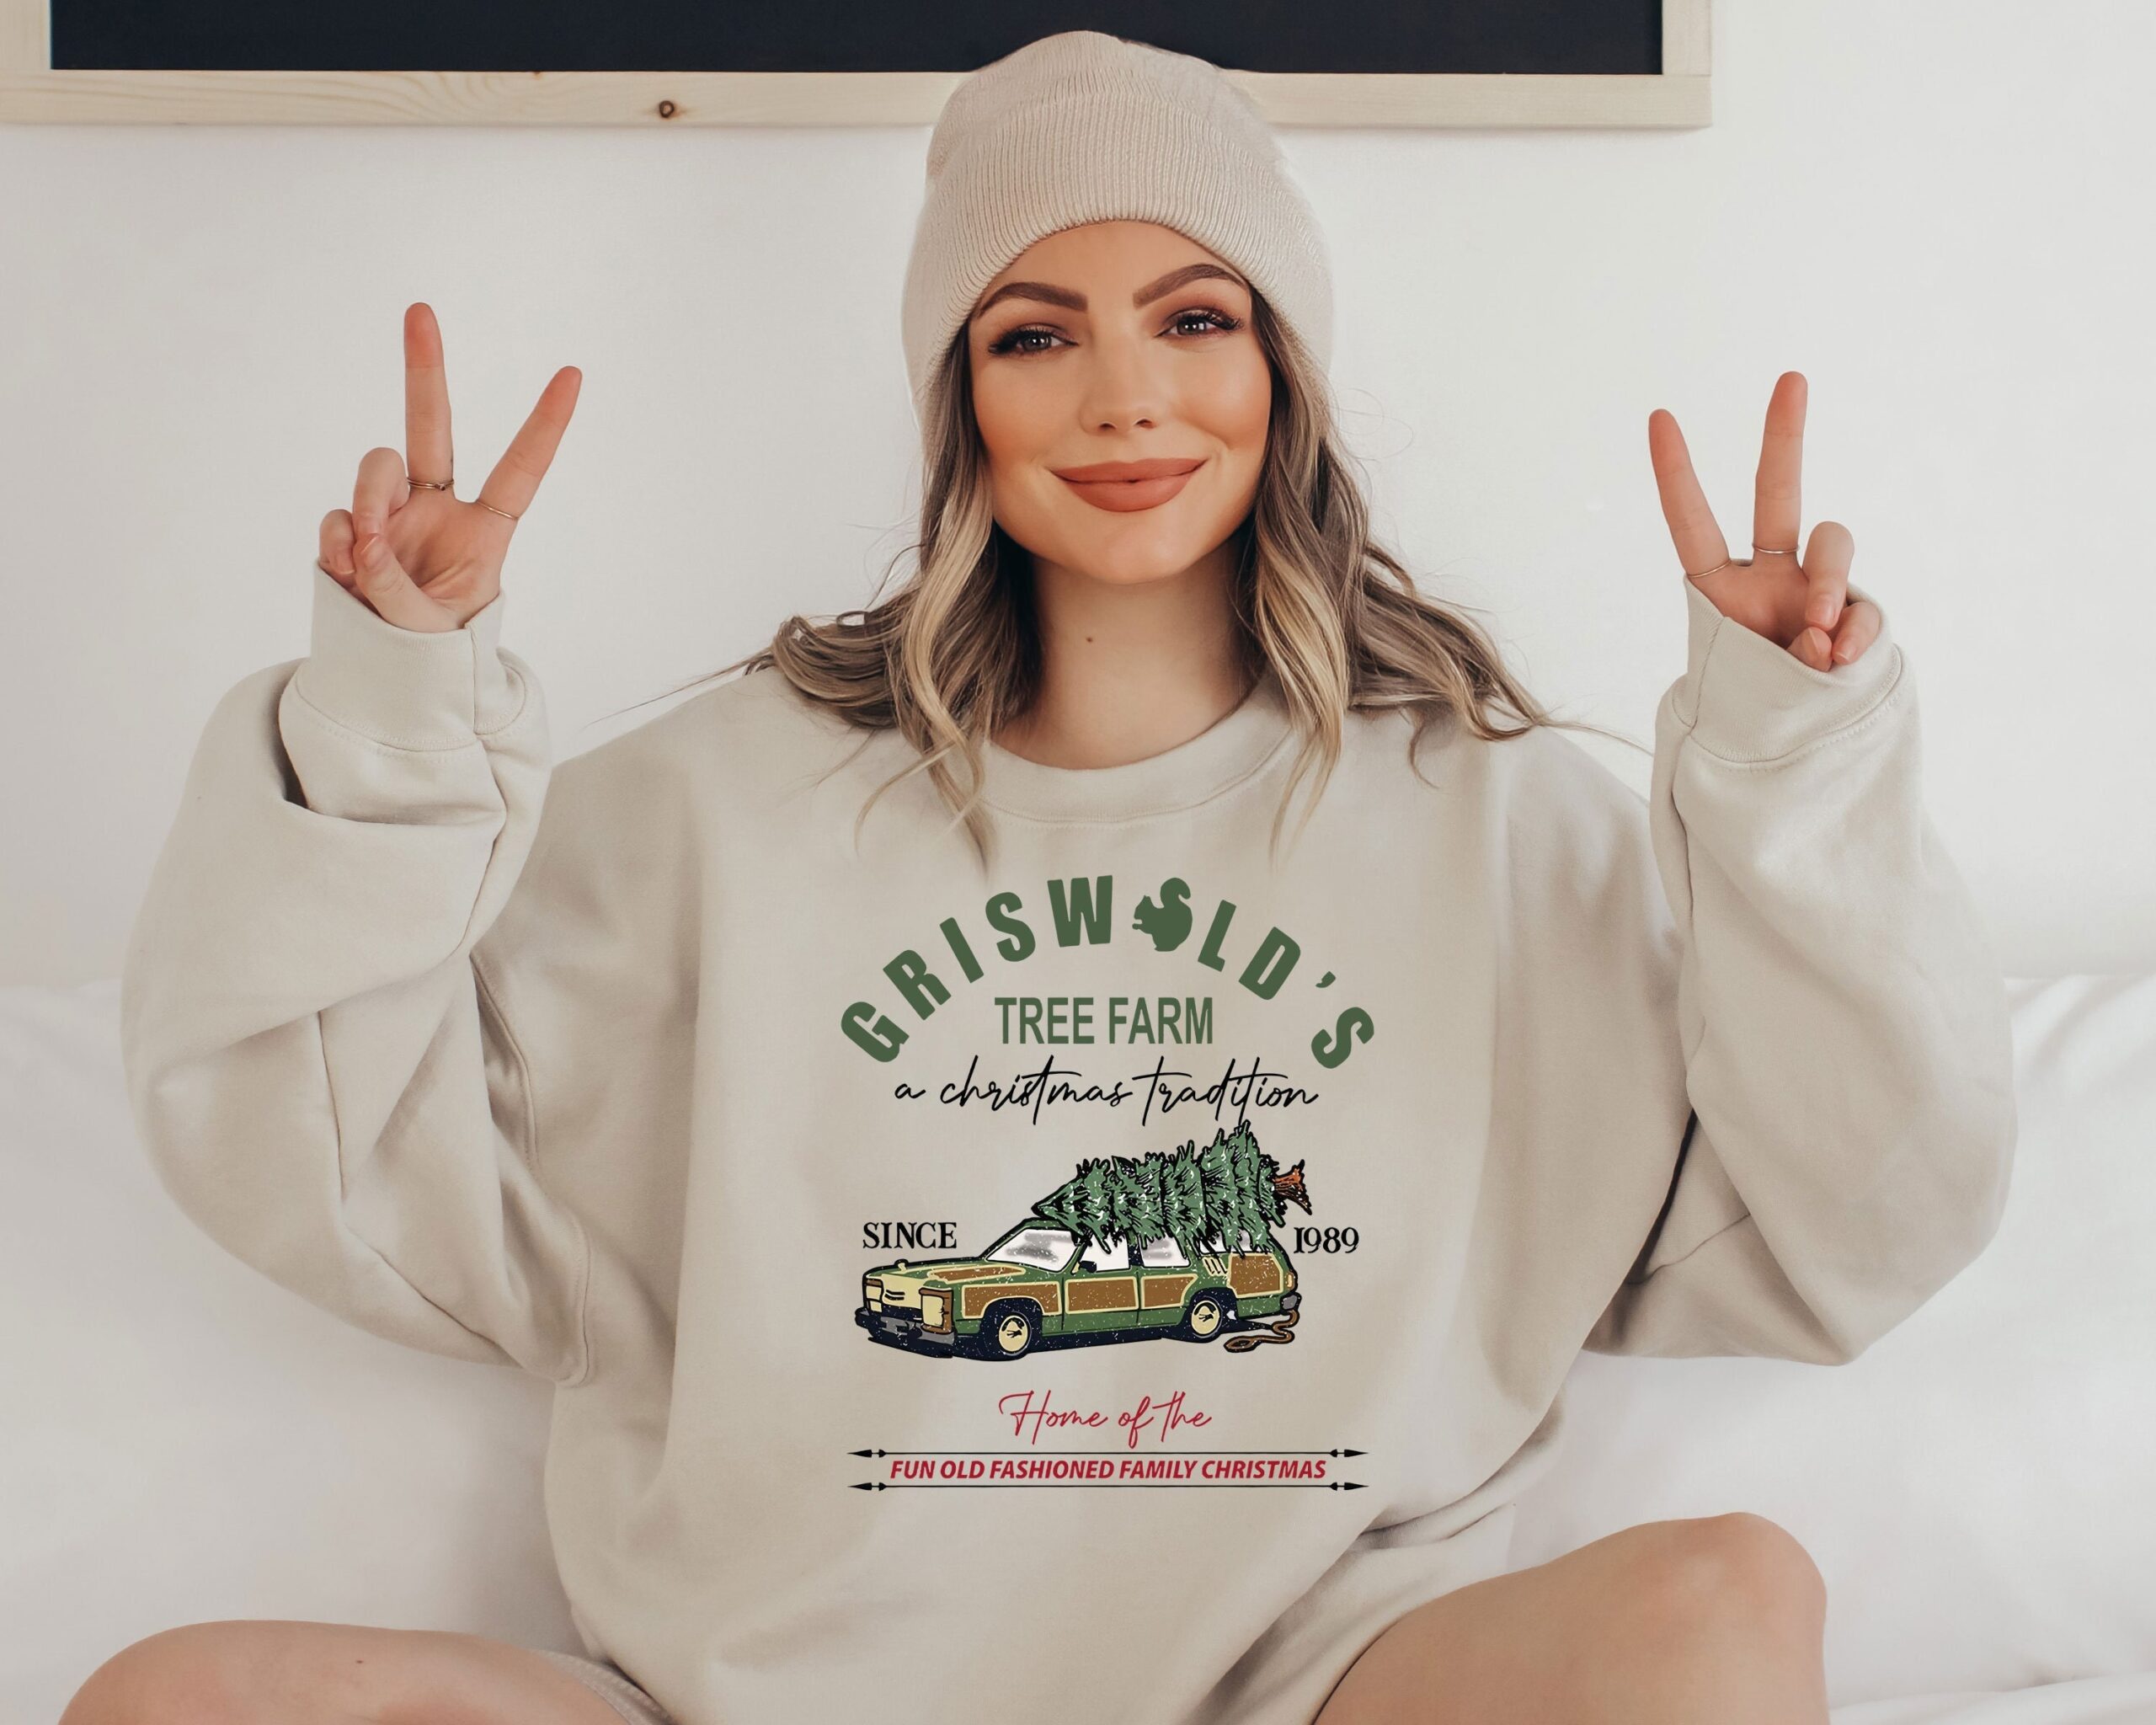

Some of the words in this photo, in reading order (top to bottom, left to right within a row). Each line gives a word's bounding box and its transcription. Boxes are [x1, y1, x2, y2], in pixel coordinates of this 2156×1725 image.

[841, 874, 1375, 1070] GRISWLD'S
[994, 996, 1096, 1044] TREE
[1108, 996, 1213, 1044] FARM
[894, 1082, 926, 1099] a
[939, 1054, 1134, 1126] christmas
[1131, 1055, 1320, 1127] tradition
[862, 1221, 958, 1250] SINCE
[1293, 1226, 1360, 1254] 1989
[998, 1390, 1108, 1445] Home
[1118, 1396, 1155, 1450] of
[1151, 1391, 1212, 1442] the
[889, 1459, 937, 1480] FUN
[939, 1459, 986, 1480] OLD
[989, 1459, 1115, 1481] FASHIONED
[1118, 1459, 1198, 1480] FAMILY
[1200, 1459, 1327, 1480] CHRISTMAS
